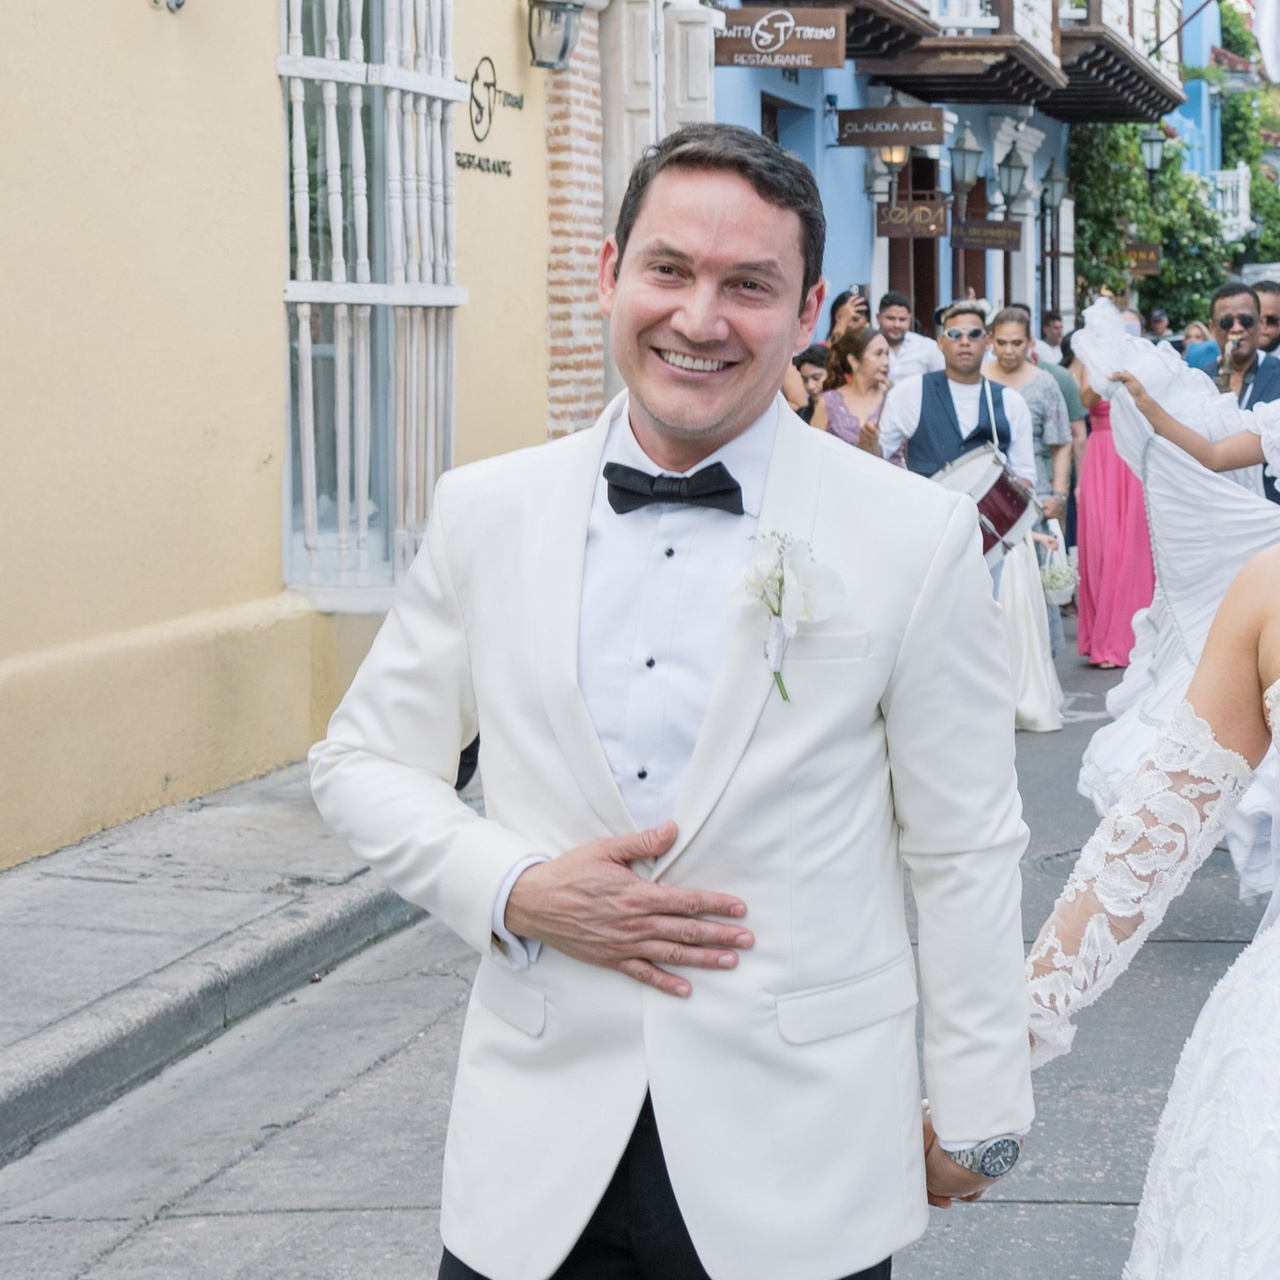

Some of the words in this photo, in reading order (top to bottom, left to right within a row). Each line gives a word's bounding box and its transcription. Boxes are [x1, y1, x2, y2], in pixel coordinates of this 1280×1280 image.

[733, 53, 813, 66] RESTAURANTE
[845, 122, 901, 133] CLAUDIA
[903, 120, 937, 132] AKEL
